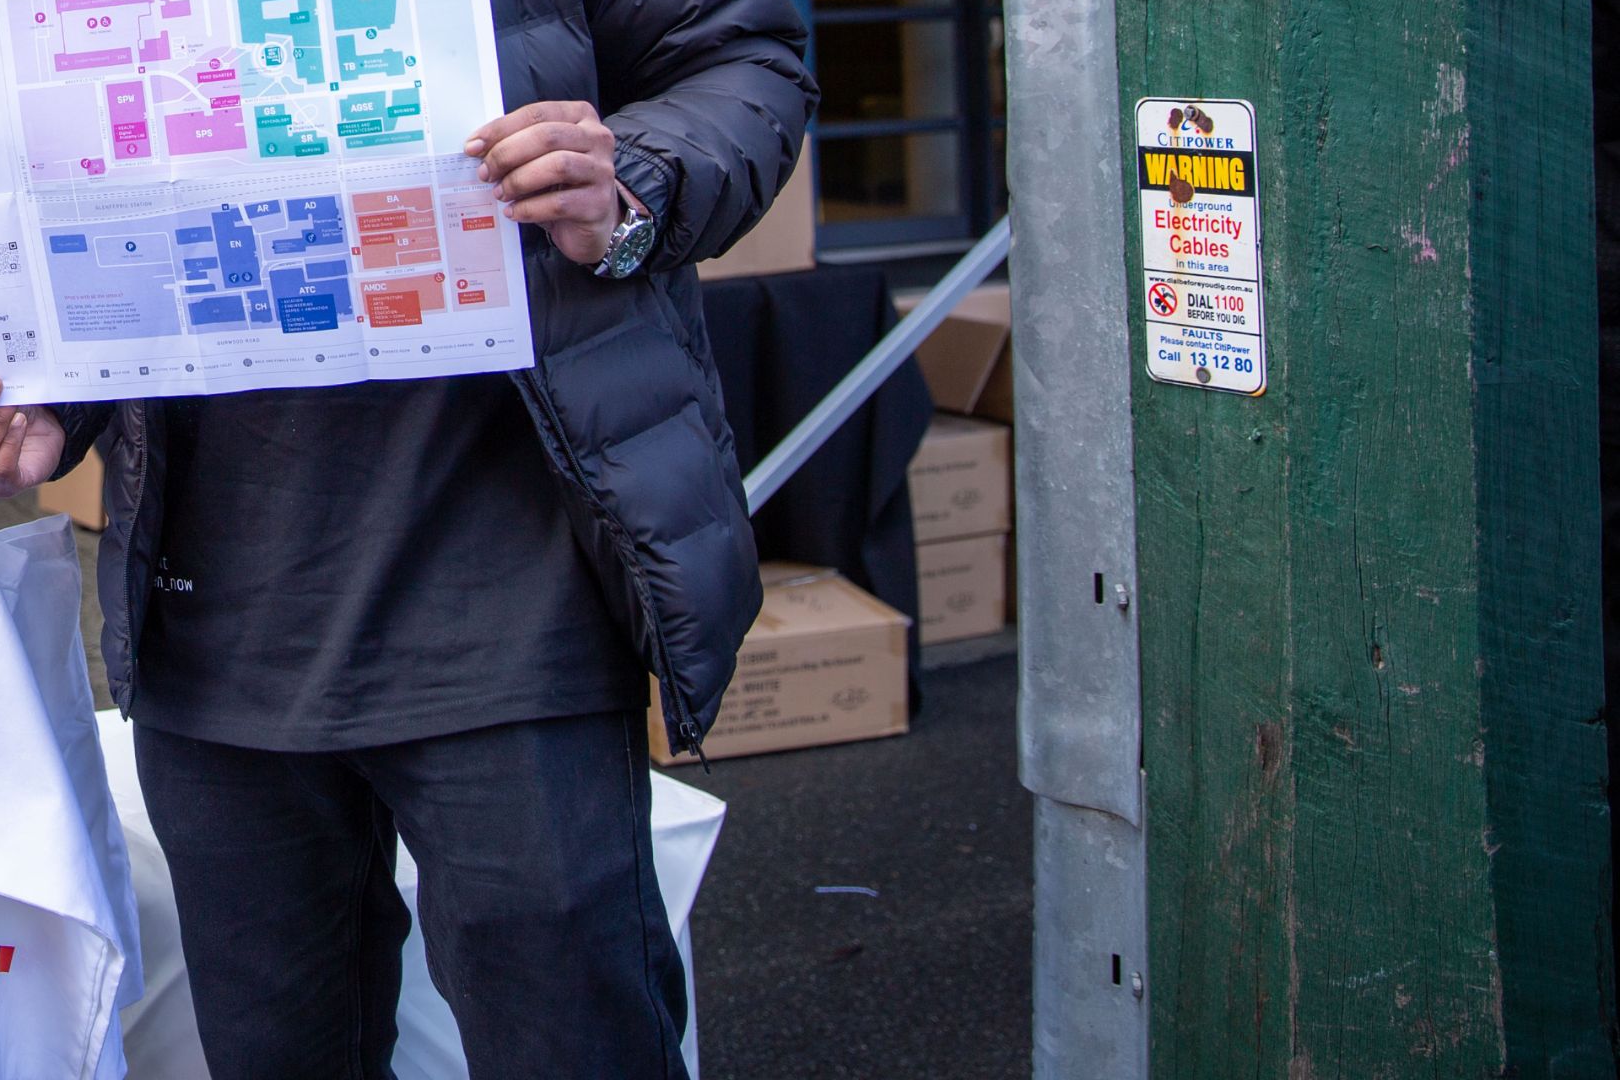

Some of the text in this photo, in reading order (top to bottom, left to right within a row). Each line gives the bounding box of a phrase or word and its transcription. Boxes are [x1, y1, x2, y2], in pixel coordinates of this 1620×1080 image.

[343, 62, 356, 71] TB
[116, 95, 135, 104] SPW
[263, 107, 276, 116] GS
[350, 102, 374, 113] AGSE
[196, 129, 213, 138] SPS
[301, 134, 314, 143] SR
[1145, 152, 1245, 192] WARNING
[386, 195, 400, 203] BA
[256, 204, 269, 213] AR
[304, 201, 317, 210] AD
[1155, 209, 1243, 240] Electricity
[229, 240, 242, 249] EN
[396, 238, 409, 247] LB
[1169, 234, 1229, 258] Cables
[1176, 259, 1229, 273] in this area
[363, 284, 387, 292] AMDC
[1149, 276, 1254, 294] www.dialbeforeyoudig.com.au
[298, 285, 317, 295] ATC
[254, 303, 268, 311] CH
[1187, 293, 1244, 313] DIAL 1100
[1187, 308, 1246, 325] BEFORE YOU DIG
[1182, 328, 1223, 342] FAULTS
[1160, 335, 1250, 355] Please contact CitiPower
[1158, 348, 1253, 374] Call 13 12 80
[64, 371, 80, 379] KEY
